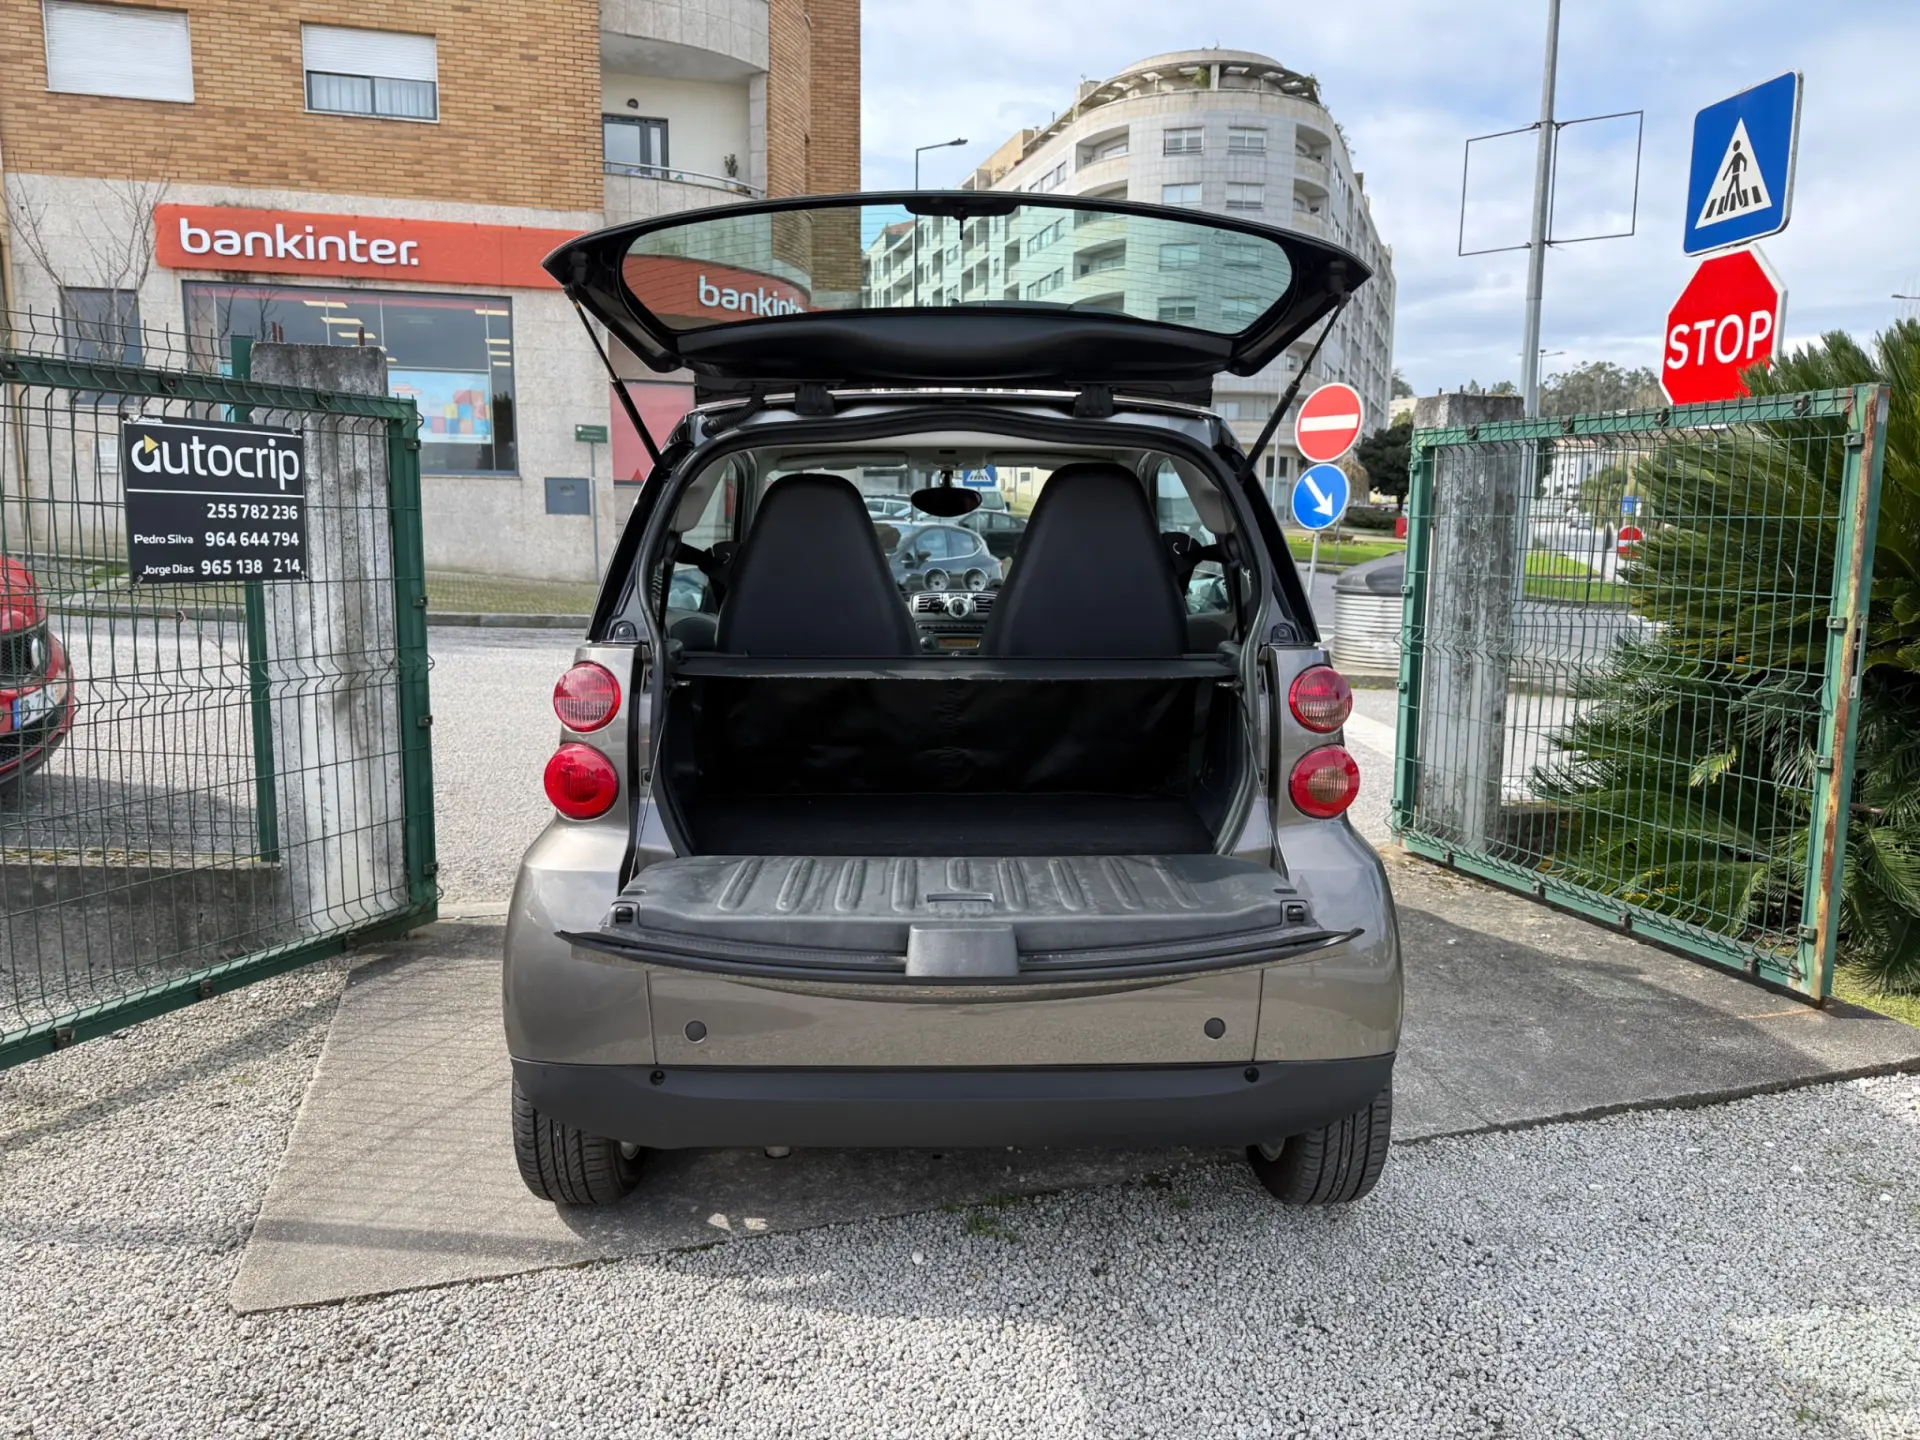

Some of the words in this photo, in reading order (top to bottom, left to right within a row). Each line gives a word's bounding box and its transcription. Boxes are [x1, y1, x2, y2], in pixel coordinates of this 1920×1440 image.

[1666, 309, 1773, 370] STOP
[131, 436, 299, 490] autocrip
[206, 503, 237, 518] 255
[240, 504, 269, 519] 782
[272, 505, 298, 519] 236
[133, 534, 166, 544] Pedro
[167, 534, 194, 544] Silva
[204, 531, 237, 547] 964
[239, 532, 269, 546] 644
[272, 532, 300, 546] 794
[142, 565, 171, 576] Jorge
[172, 564, 194, 574] Dias
[201, 560, 232, 575] 965
[235, 559, 262, 574] 138
[273, 558, 300, 573] 214
